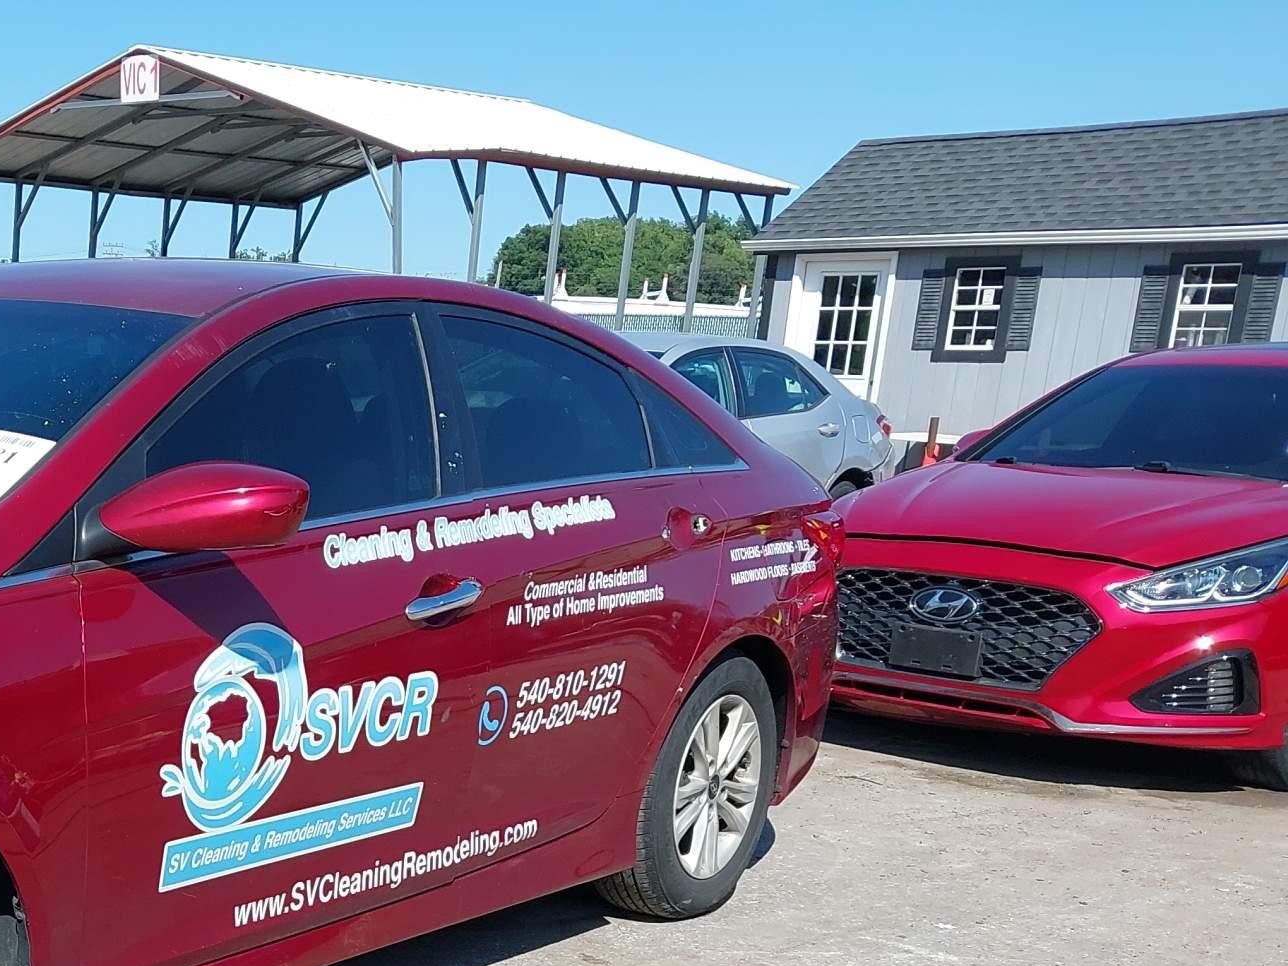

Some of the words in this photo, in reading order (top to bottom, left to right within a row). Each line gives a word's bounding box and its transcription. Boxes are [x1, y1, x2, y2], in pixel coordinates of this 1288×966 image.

[123, 61, 146, 96] VIC
[150, 60, 158, 93] 1
[323, 526, 414, 568] Cleaning
[416, 520, 434, 551] &
[532, 495, 616, 535] Specialists
[730, 545, 761, 561] KITCHENS
[524, 574, 586, 601] Commercial
[730, 567, 768, 585] HARDWOOD
[768, 564, 789, 579] FLOORS
[506, 604, 522, 626] All
[524, 603, 551, 628] Type
[552, 598, 565, 618] of
[566, 596, 596, 616] Home
[597, 585, 665, 614] Improvements
[516, 660, 626, 709] 540-810-1291
[300, 670, 439, 761] SVCR
[509, 689, 622, 740] 540-820-4912
[168, 852, 192, 874] SV
[192, 840, 248, 868] Cleaning
[251, 834, 261, 852] &
[264, 816, 336, 850] Remodeling
[337, 805, 386, 831] Services
[388, 797, 414, 818] LLC
[233, 818, 538, 928] www.SVCleaningRemodeling.com
